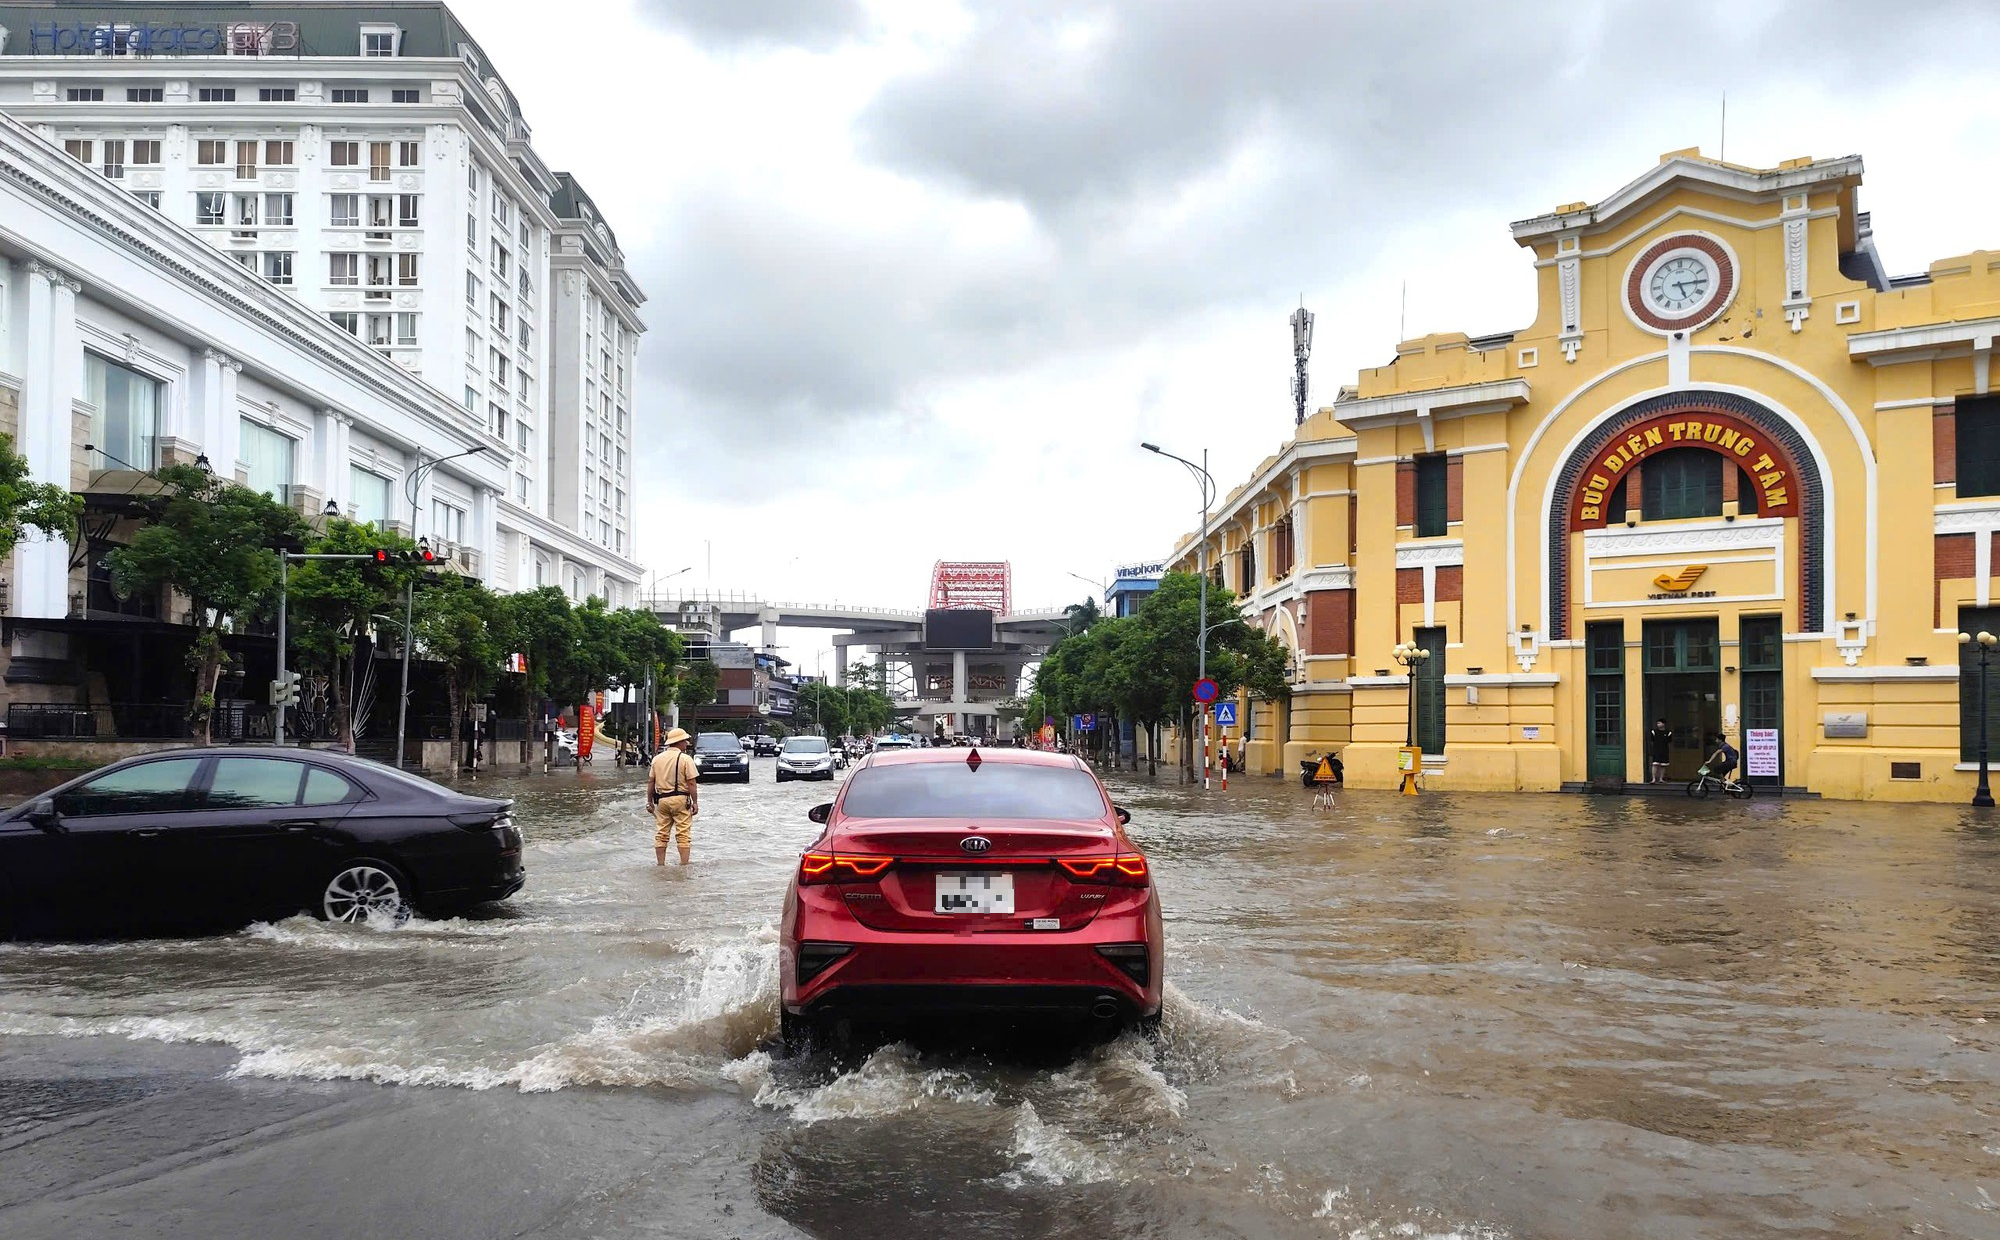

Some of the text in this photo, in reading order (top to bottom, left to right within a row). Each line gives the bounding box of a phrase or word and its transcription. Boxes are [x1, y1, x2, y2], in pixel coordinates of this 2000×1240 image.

[1581, 422, 1788, 520] BƯU ĐIỆN TRUNG TÂM
[1117, 563, 1164, 577] vinaphone
[1648, 592, 1687, 600] VIETNAM
[966, 840, 986, 849] KIA
